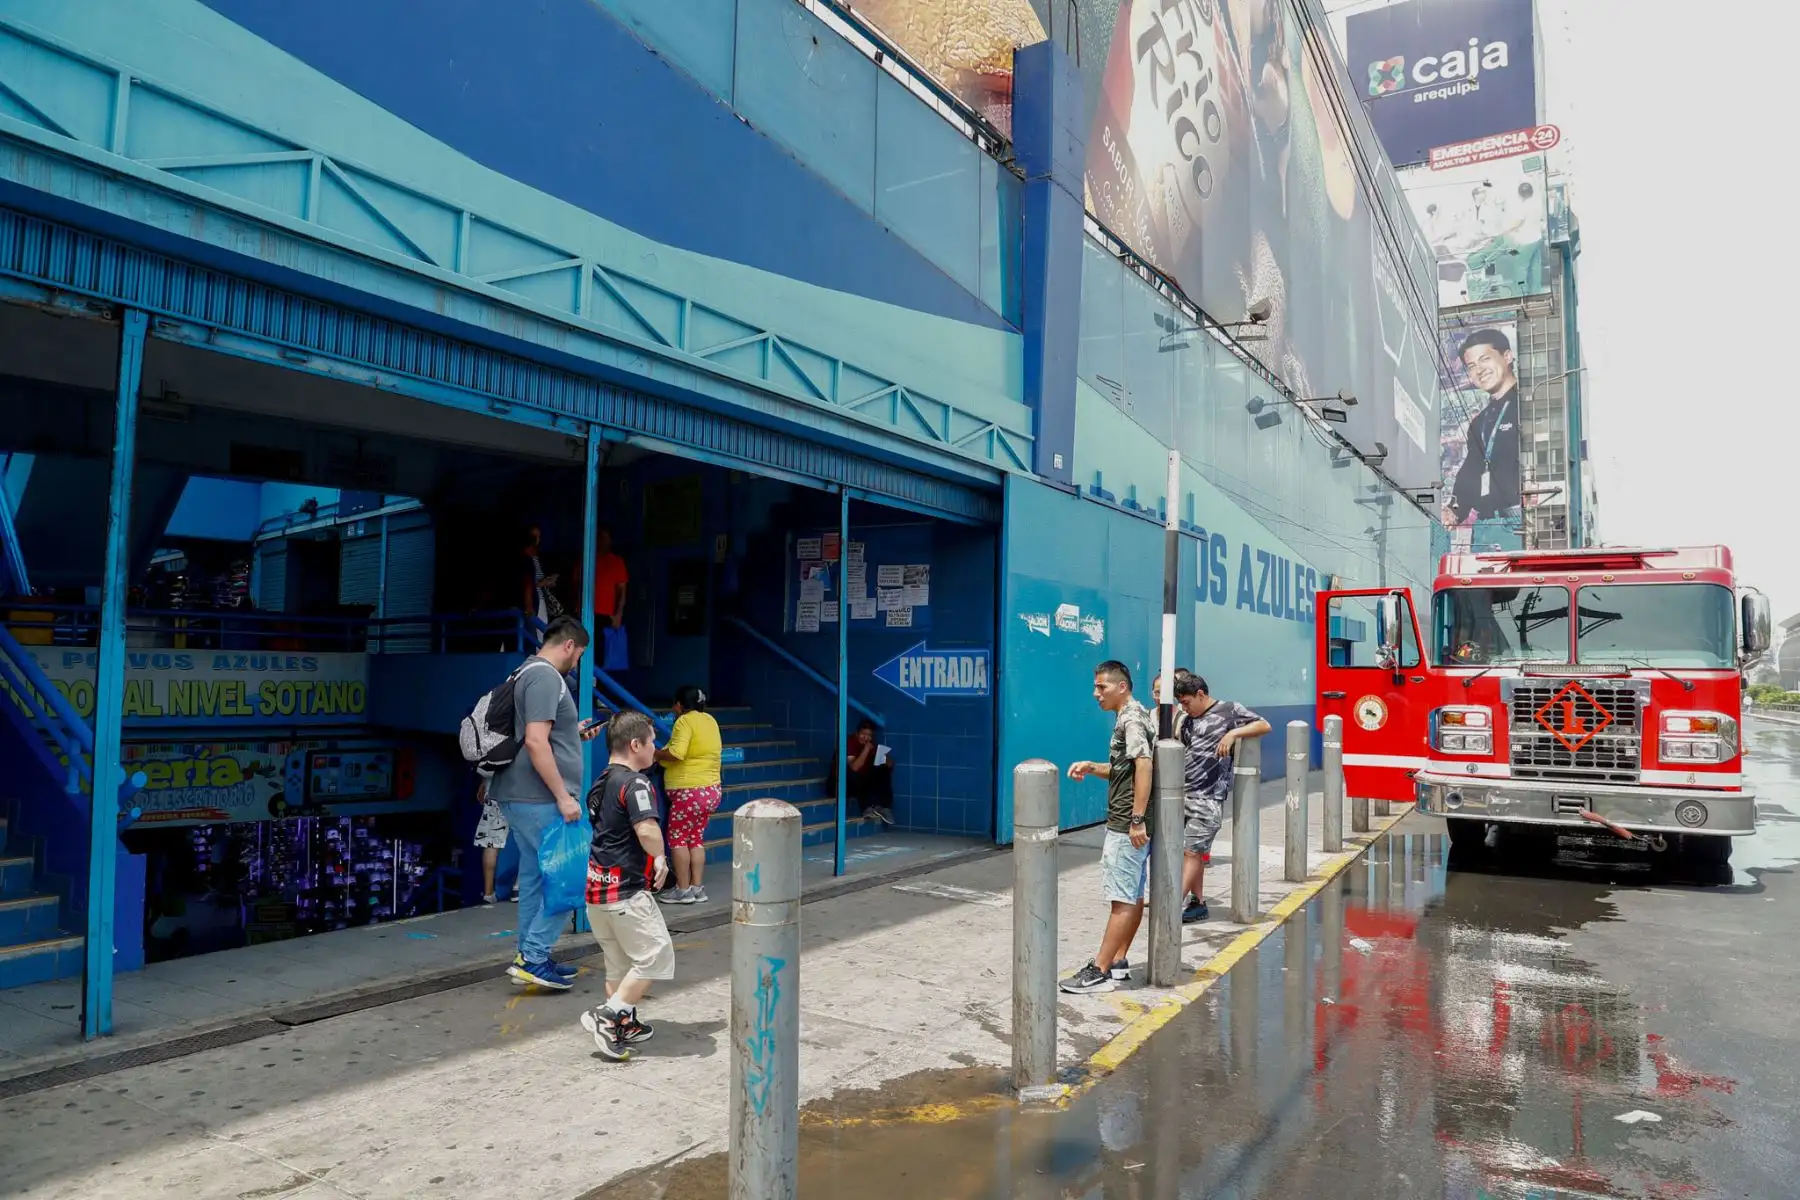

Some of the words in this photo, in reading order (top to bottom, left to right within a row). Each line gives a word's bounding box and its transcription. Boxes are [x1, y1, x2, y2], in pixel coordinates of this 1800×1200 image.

[1412, 37, 1508, 84] caja
[1413, 80, 1480, 103] arequipa
[1102, 125, 1136, 201] SABOR
[1432, 131, 1529, 161] EMERGENCIA
[1236, 542, 1316, 625] AZULES
[212, 653, 319, 672] AZULES
[900, 656, 987, 689] ENTRADA
[167, 679, 254, 717] NIVEL
[257, 679, 367, 716] SOTANO
[1562, 700, 1587, 734] L
